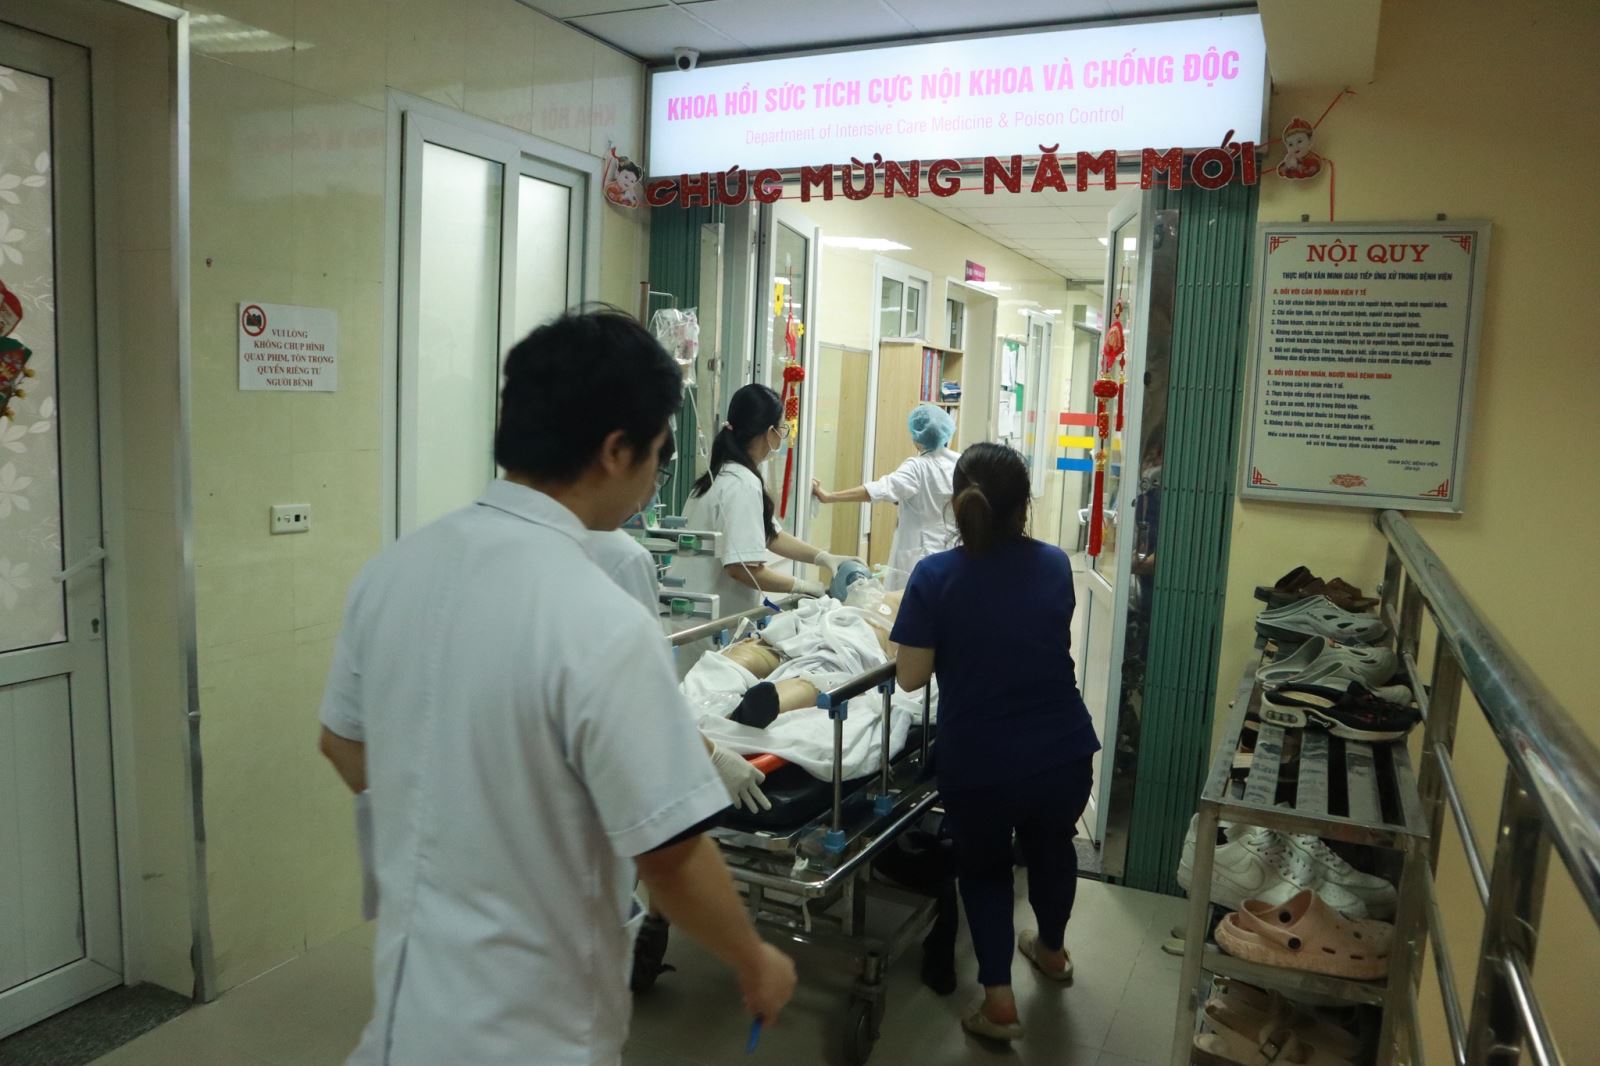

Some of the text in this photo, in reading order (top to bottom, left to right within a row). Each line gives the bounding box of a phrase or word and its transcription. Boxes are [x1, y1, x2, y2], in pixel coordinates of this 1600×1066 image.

[667, 46, 1240, 120] KHOA HỒI SỨC TÍCH CỰC NỘI KHOA VÀ CHỐNG ĐỘC
[746, 106, 1124, 144] Department of Intensive Care Medicine & Poison Control
[645, 129, 1257, 208] CHÚC MỪNG NĂM MỚI
[1306, 239, 1429, 268] NỘI QUY
[1297, 271, 1312, 279] HIỆN
[1418, 272, 1436, 280] BỆNH
[1437, 272, 1452, 280] VIỆN
